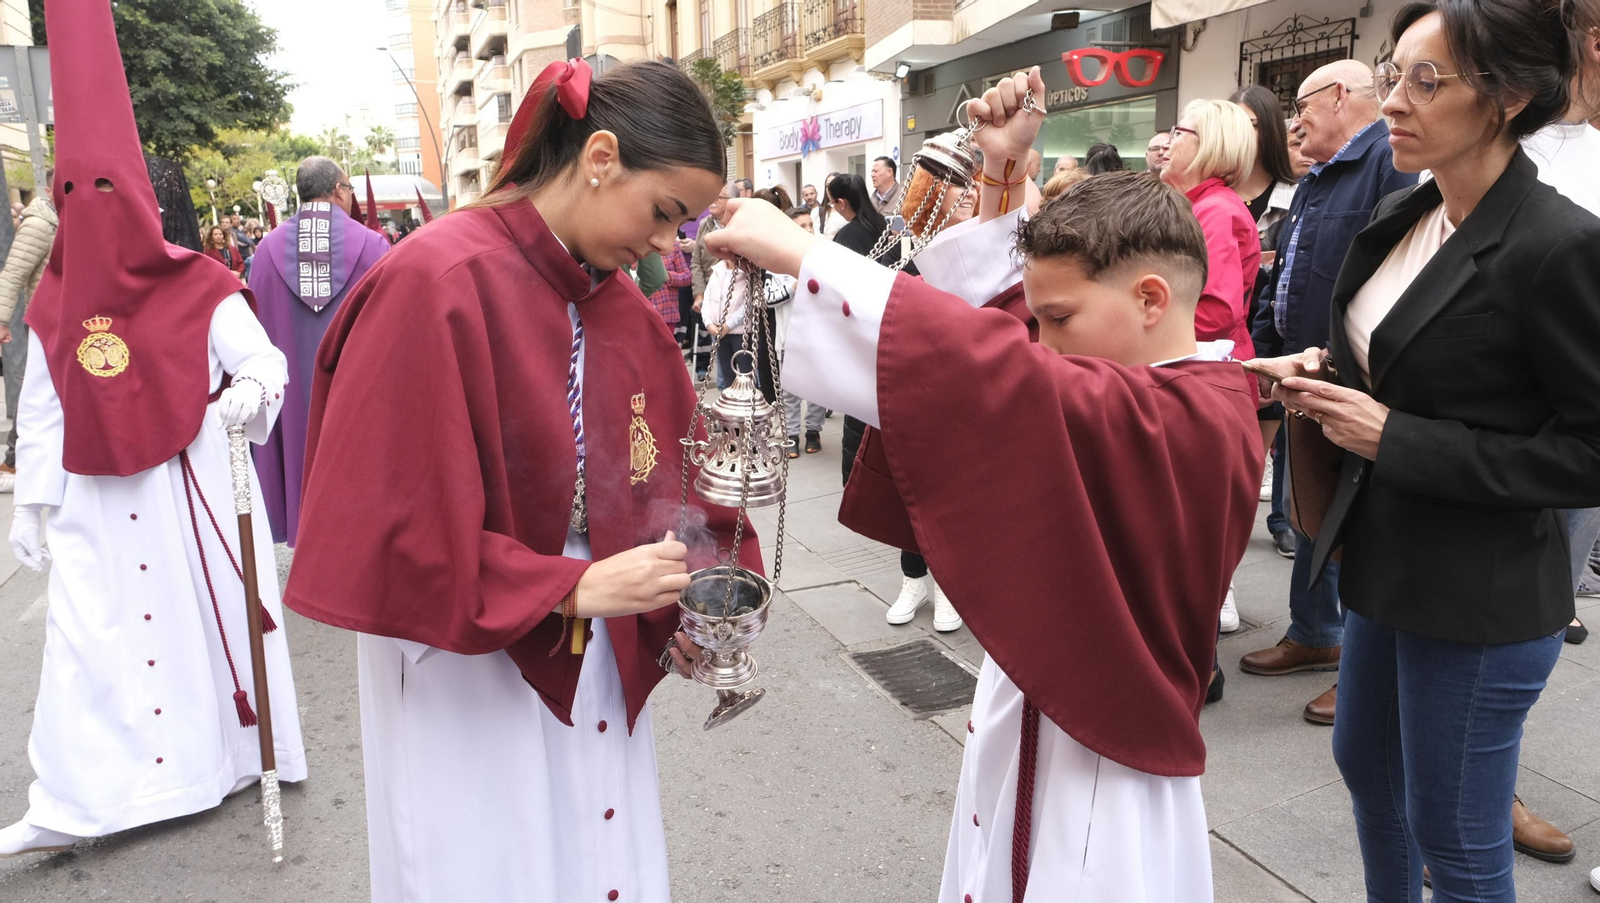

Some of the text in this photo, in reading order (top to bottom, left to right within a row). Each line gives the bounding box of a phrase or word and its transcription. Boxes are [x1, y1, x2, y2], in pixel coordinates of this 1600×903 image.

[1047, 86, 1087, 106] ÓPTICOS
[780, 115, 862, 150] Body Therapy
